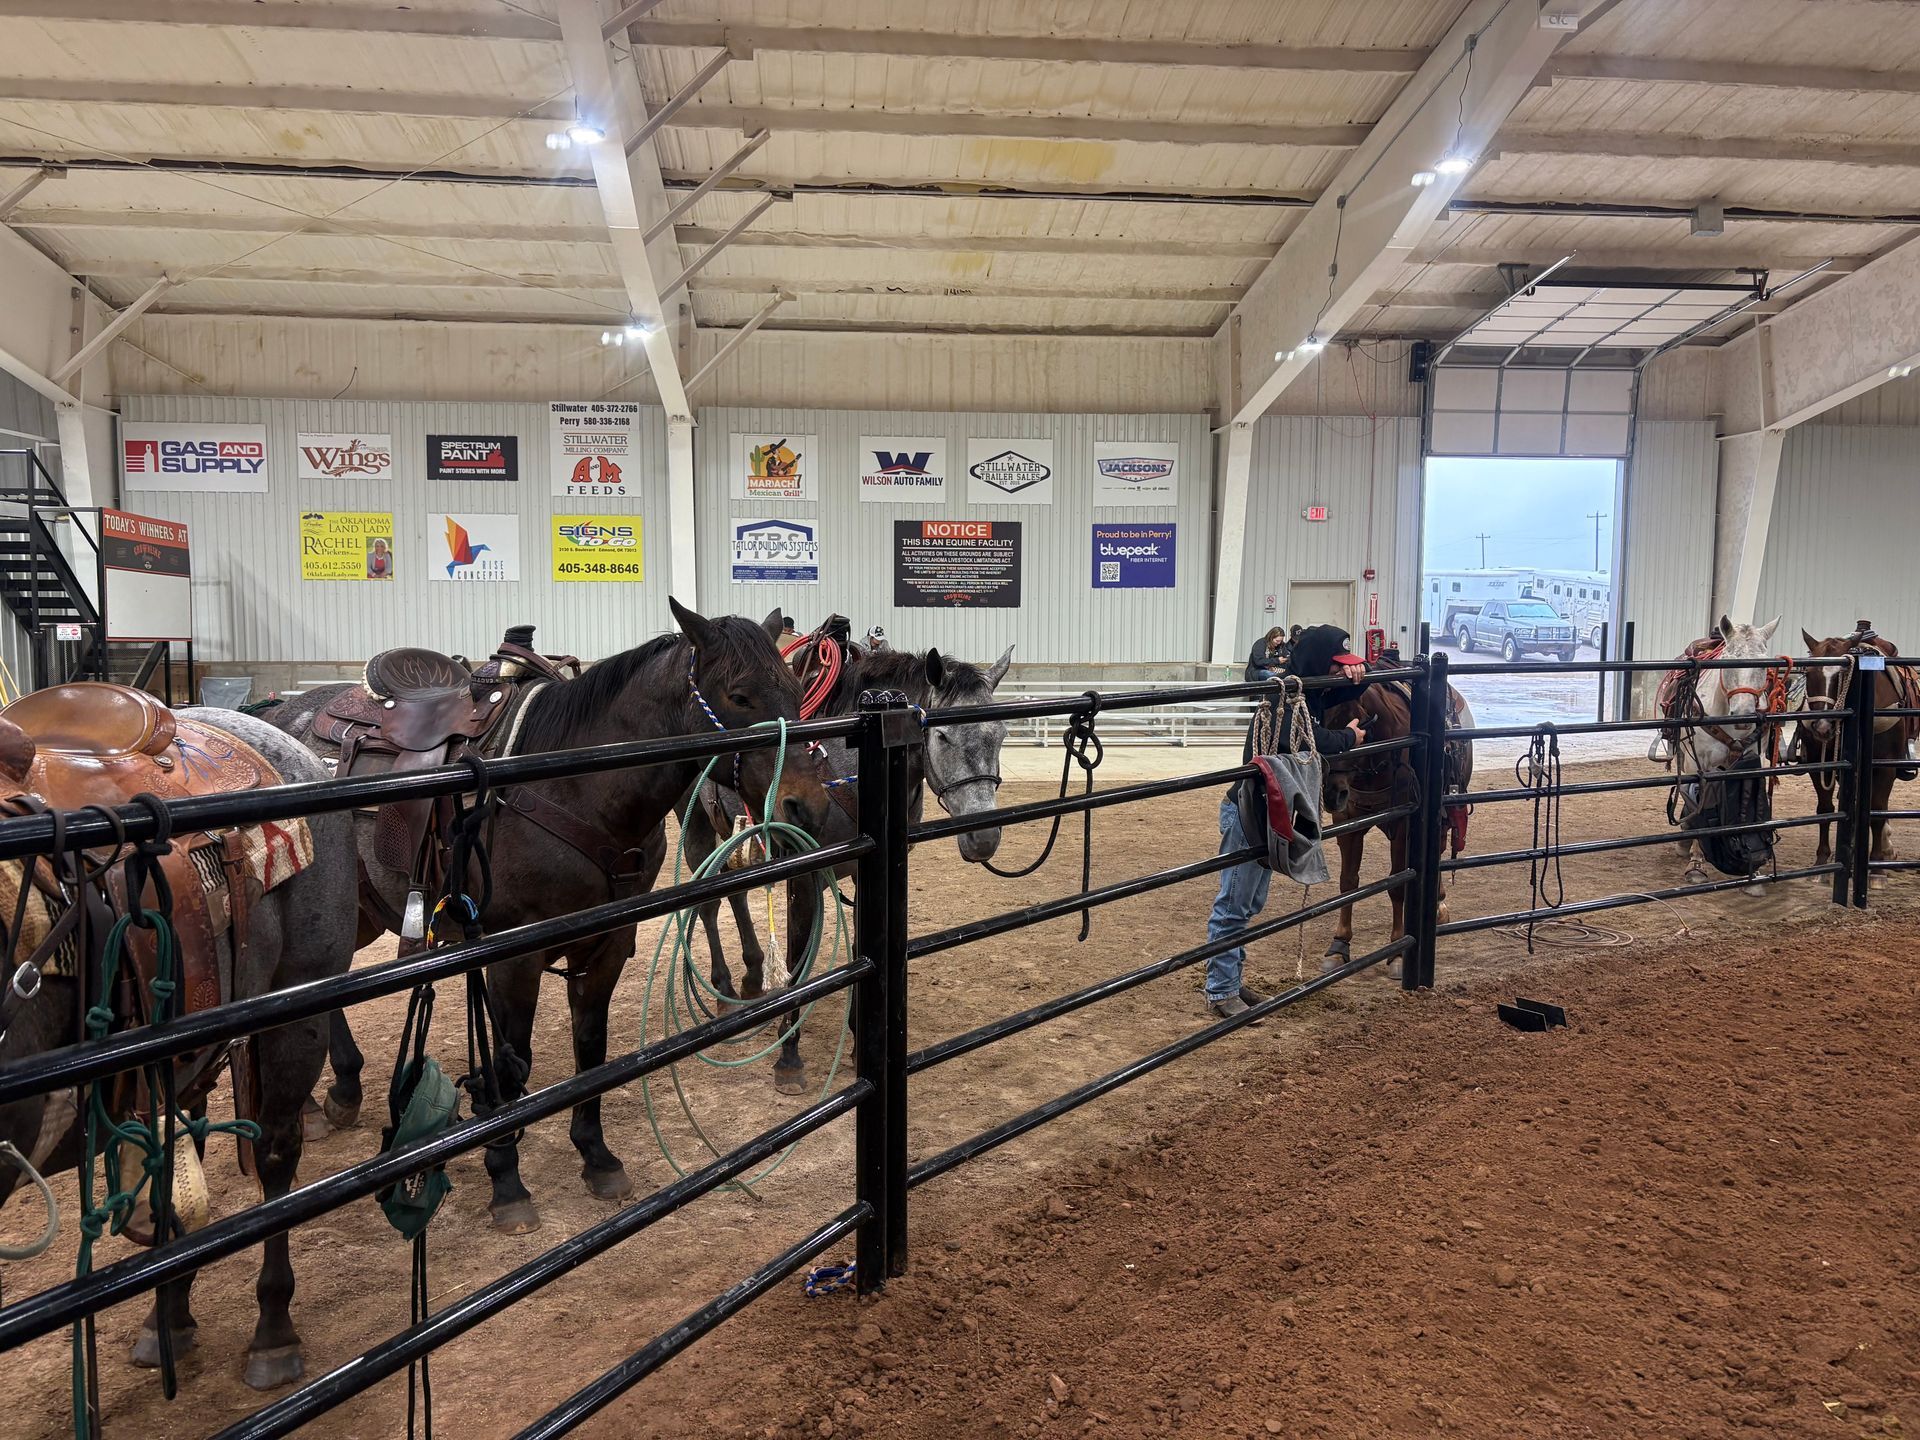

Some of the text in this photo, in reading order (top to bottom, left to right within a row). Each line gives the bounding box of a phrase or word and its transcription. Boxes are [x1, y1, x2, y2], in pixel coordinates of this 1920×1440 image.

[551, 404, 638, 413] Stillwater 405-372-2766
[560, 417, 580, 426] Perry
[563, 436, 628, 444] STILLWATER
[161, 441, 259, 456] GAS AND
[441, 442, 501, 450] SPECTRUM
[441, 450, 490, 460] PAINT
[162, 458, 265, 473] SUPPLY
[300, 446, 390, 475] Wings
[571, 457, 593, 482] A
[597, 456, 622, 483] M
[980, 462, 1041, 472] STILLWATER
[1105, 464, 1167, 473] JACKSONS
[750, 478, 797, 488] MARIACHI
[861, 476, 944, 486] WILSON AUTO FAMILY
[567, 486, 627, 496] FEEDS
[1310, 508, 1325, 518] EXIT
[340, 516, 391, 525] OKLAHOMA
[104, 514, 187, 542] TODAY'S WINNERS AT
[329, 520, 360, 534] LAND
[364, 520, 391, 534] LADY
[558, 526, 633, 536] SIGNS
[927, 524, 988, 536] NOTICE
[1096, 530, 1120, 538] Proud
[1148, 530, 1172, 540] Perry!
[303, 536, 362, 556] RACHEL
[759, 541, 788, 552] BUILDING
[788, 542, 818, 552] SYSTEMS
[1100, 543, 1158, 558] bluepeak
[304, 562, 362, 570] 405.612.5550
[482, 560, 504, 570] RISE
[558, 564, 640, 574] 405-348-8646
[458, 570, 504, 580] CONCEPTS
